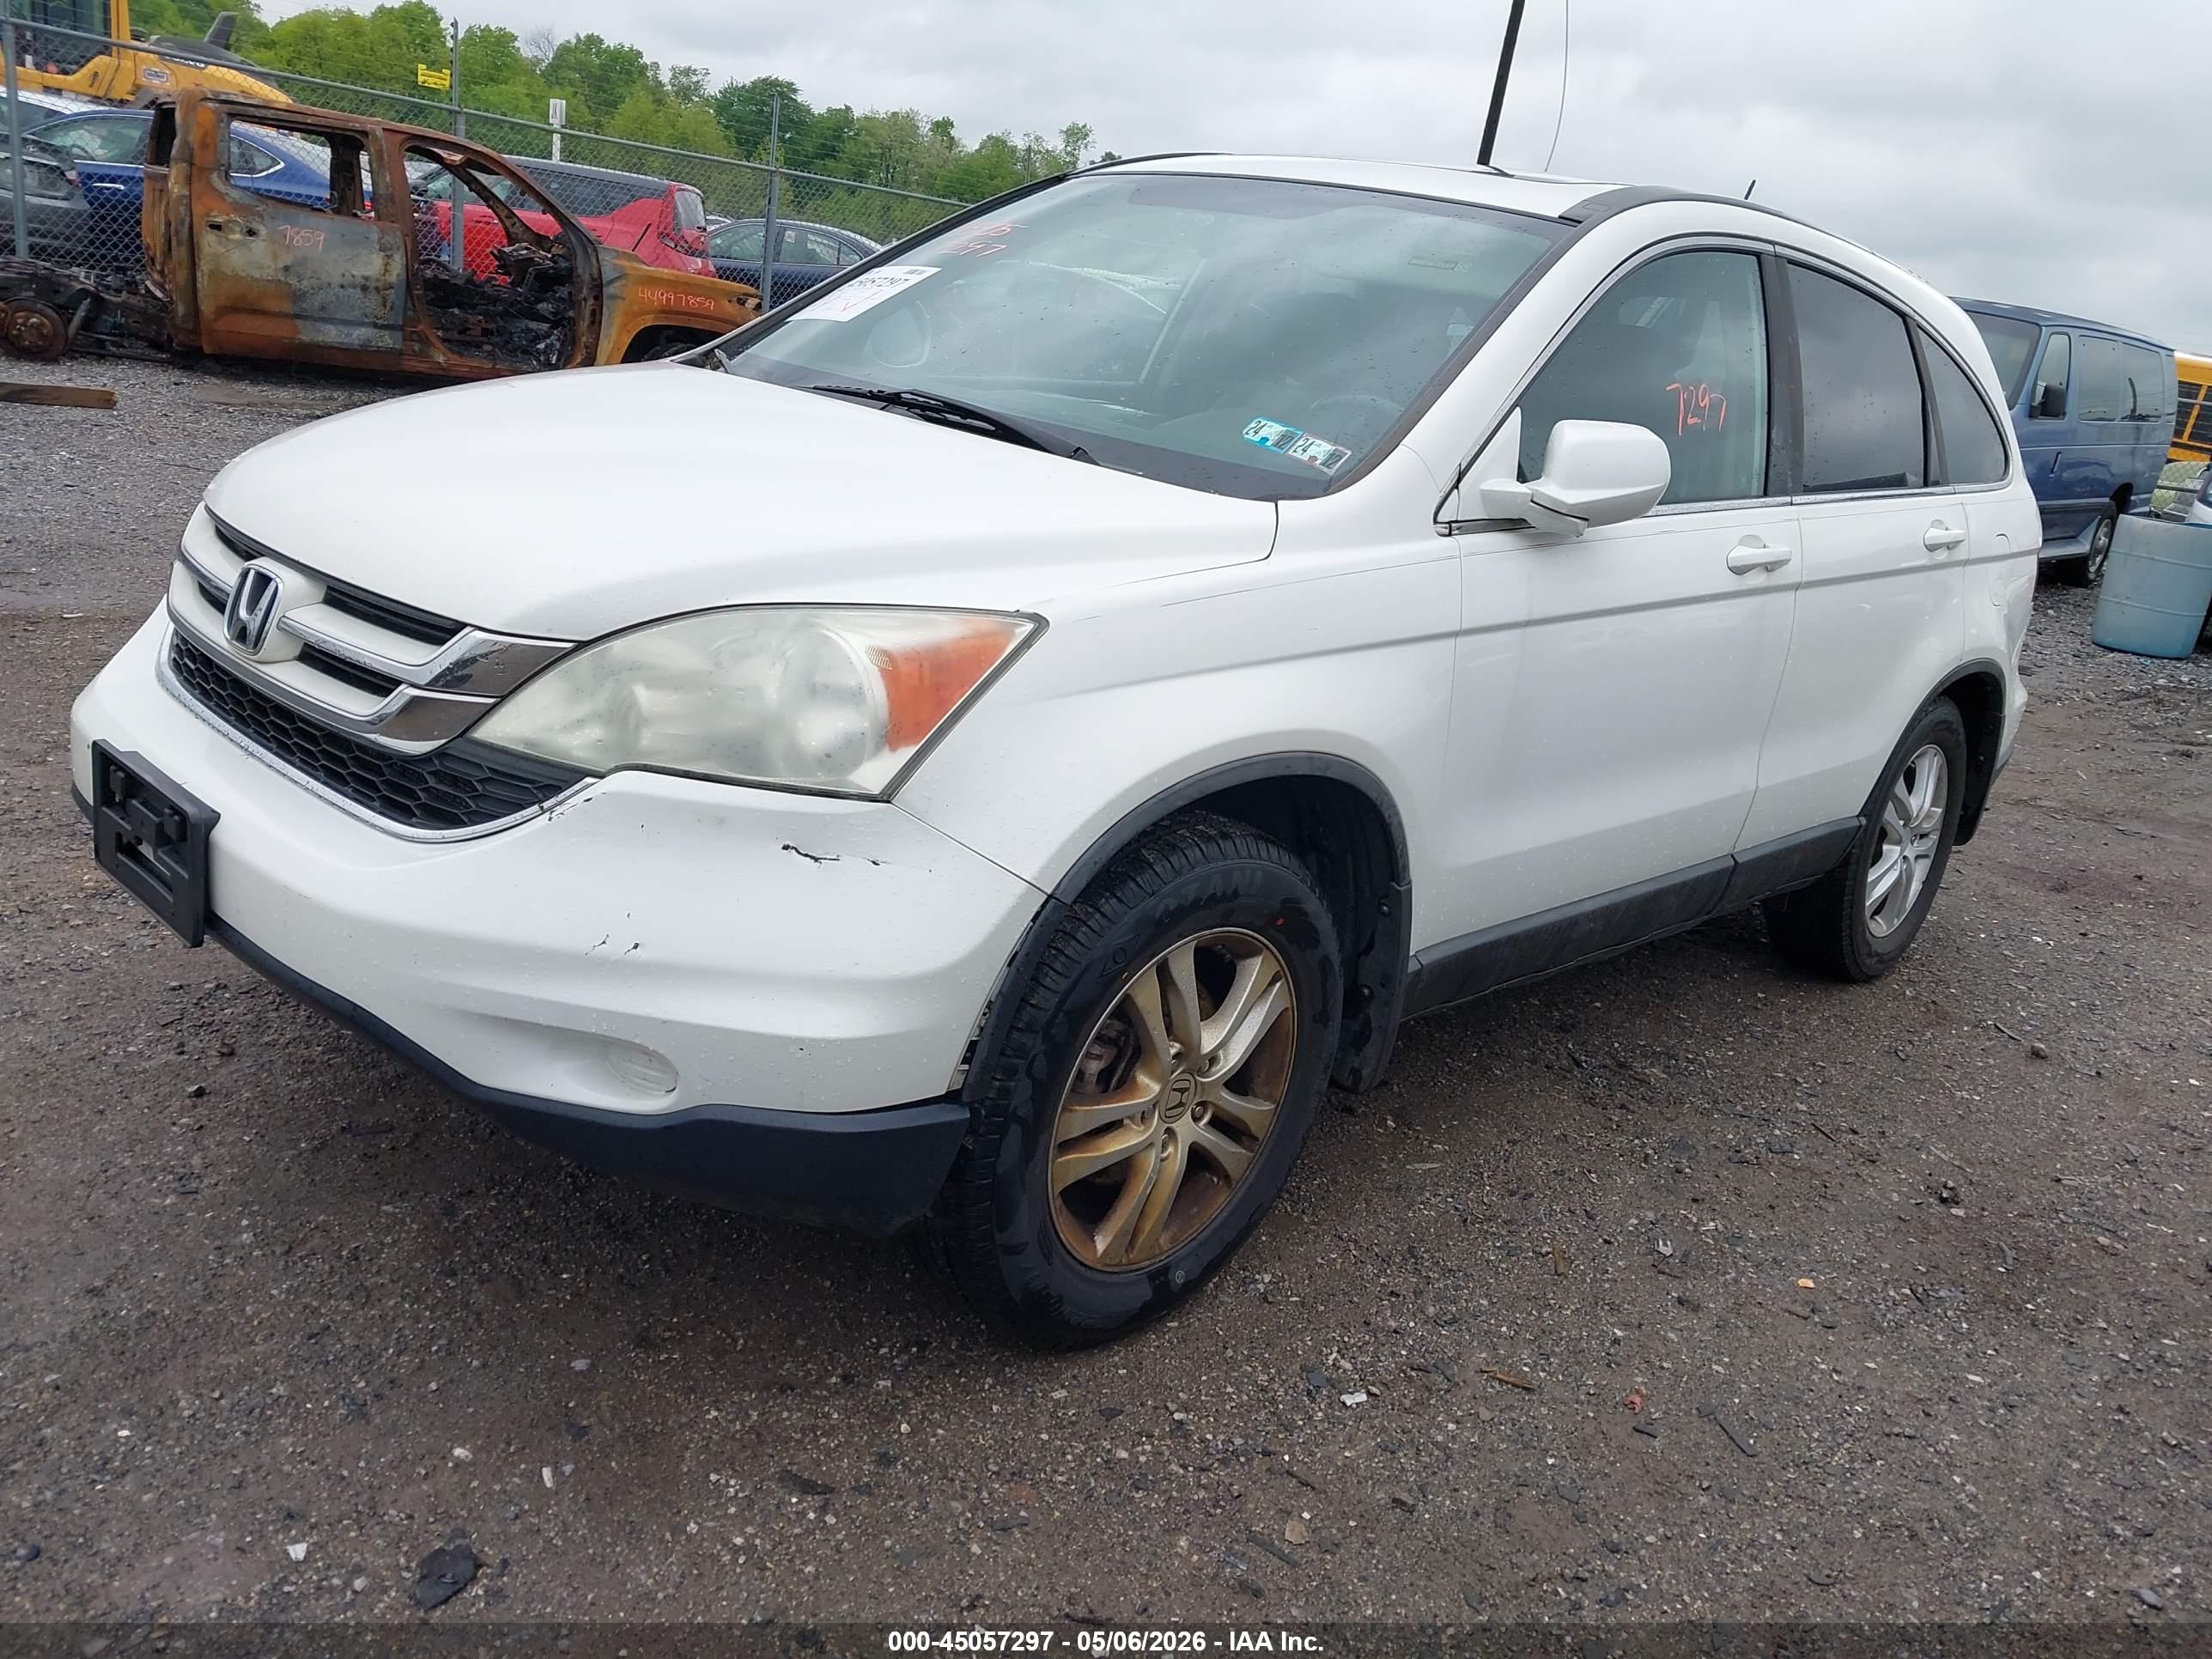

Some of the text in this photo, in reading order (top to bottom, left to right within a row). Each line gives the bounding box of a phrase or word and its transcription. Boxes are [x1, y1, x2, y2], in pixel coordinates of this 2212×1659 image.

[277, 225, 324, 252] 7859
[638, 286, 715, 310] 44997859
[1666, 383, 1727, 436] 7297
[1244, 420, 1268, 438] 24
[1292, 437, 1316, 456] 24
